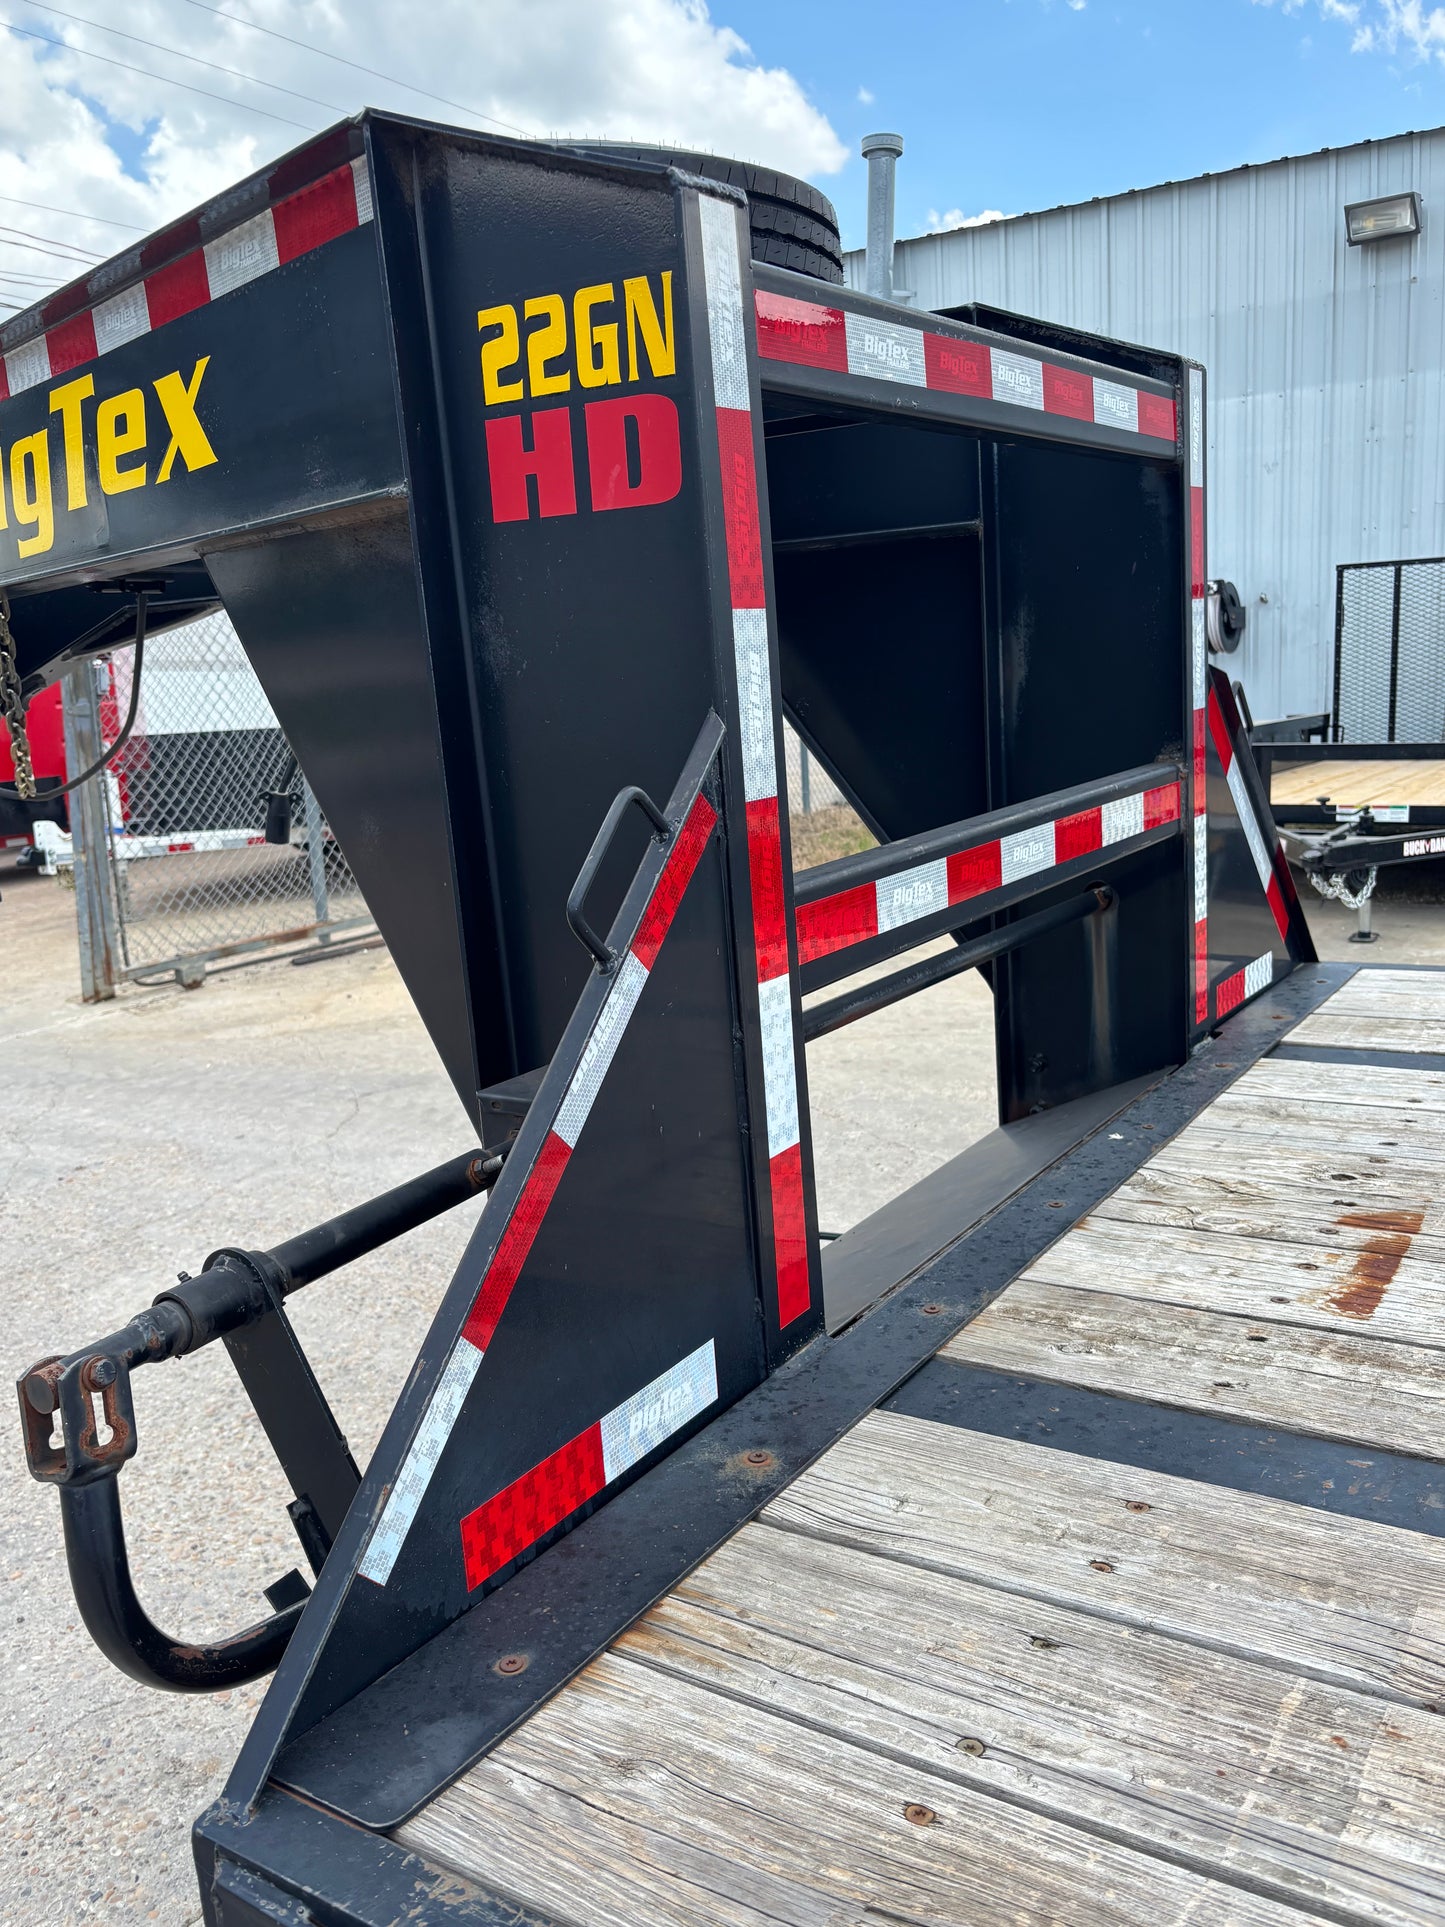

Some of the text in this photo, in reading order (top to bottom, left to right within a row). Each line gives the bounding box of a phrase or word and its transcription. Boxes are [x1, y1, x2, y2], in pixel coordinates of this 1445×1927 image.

[221, 240, 260, 270] BigTex
[105, 305, 136, 331] BigTex
[478, 270, 676, 406] 22GN
[864, 334, 908, 361] BigTex
[940, 351, 977, 376] BigTex
[998, 365, 1031, 388] BigTex
[1053, 380, 1083, 400] BigTex
[1103, 393, 1129, 412] BigTex
[484, 393, 683, 524] HD
[748, 651, 764, 757] BigTex
[1013, 842, 1044, 862] BigTex
[1403, 839, 1426, 857] BUCK
[961, 857, 995, 881] BigTex
[893, 881, 932, 906] BigTex
[629, 1378, 693, 1439] BigTex
